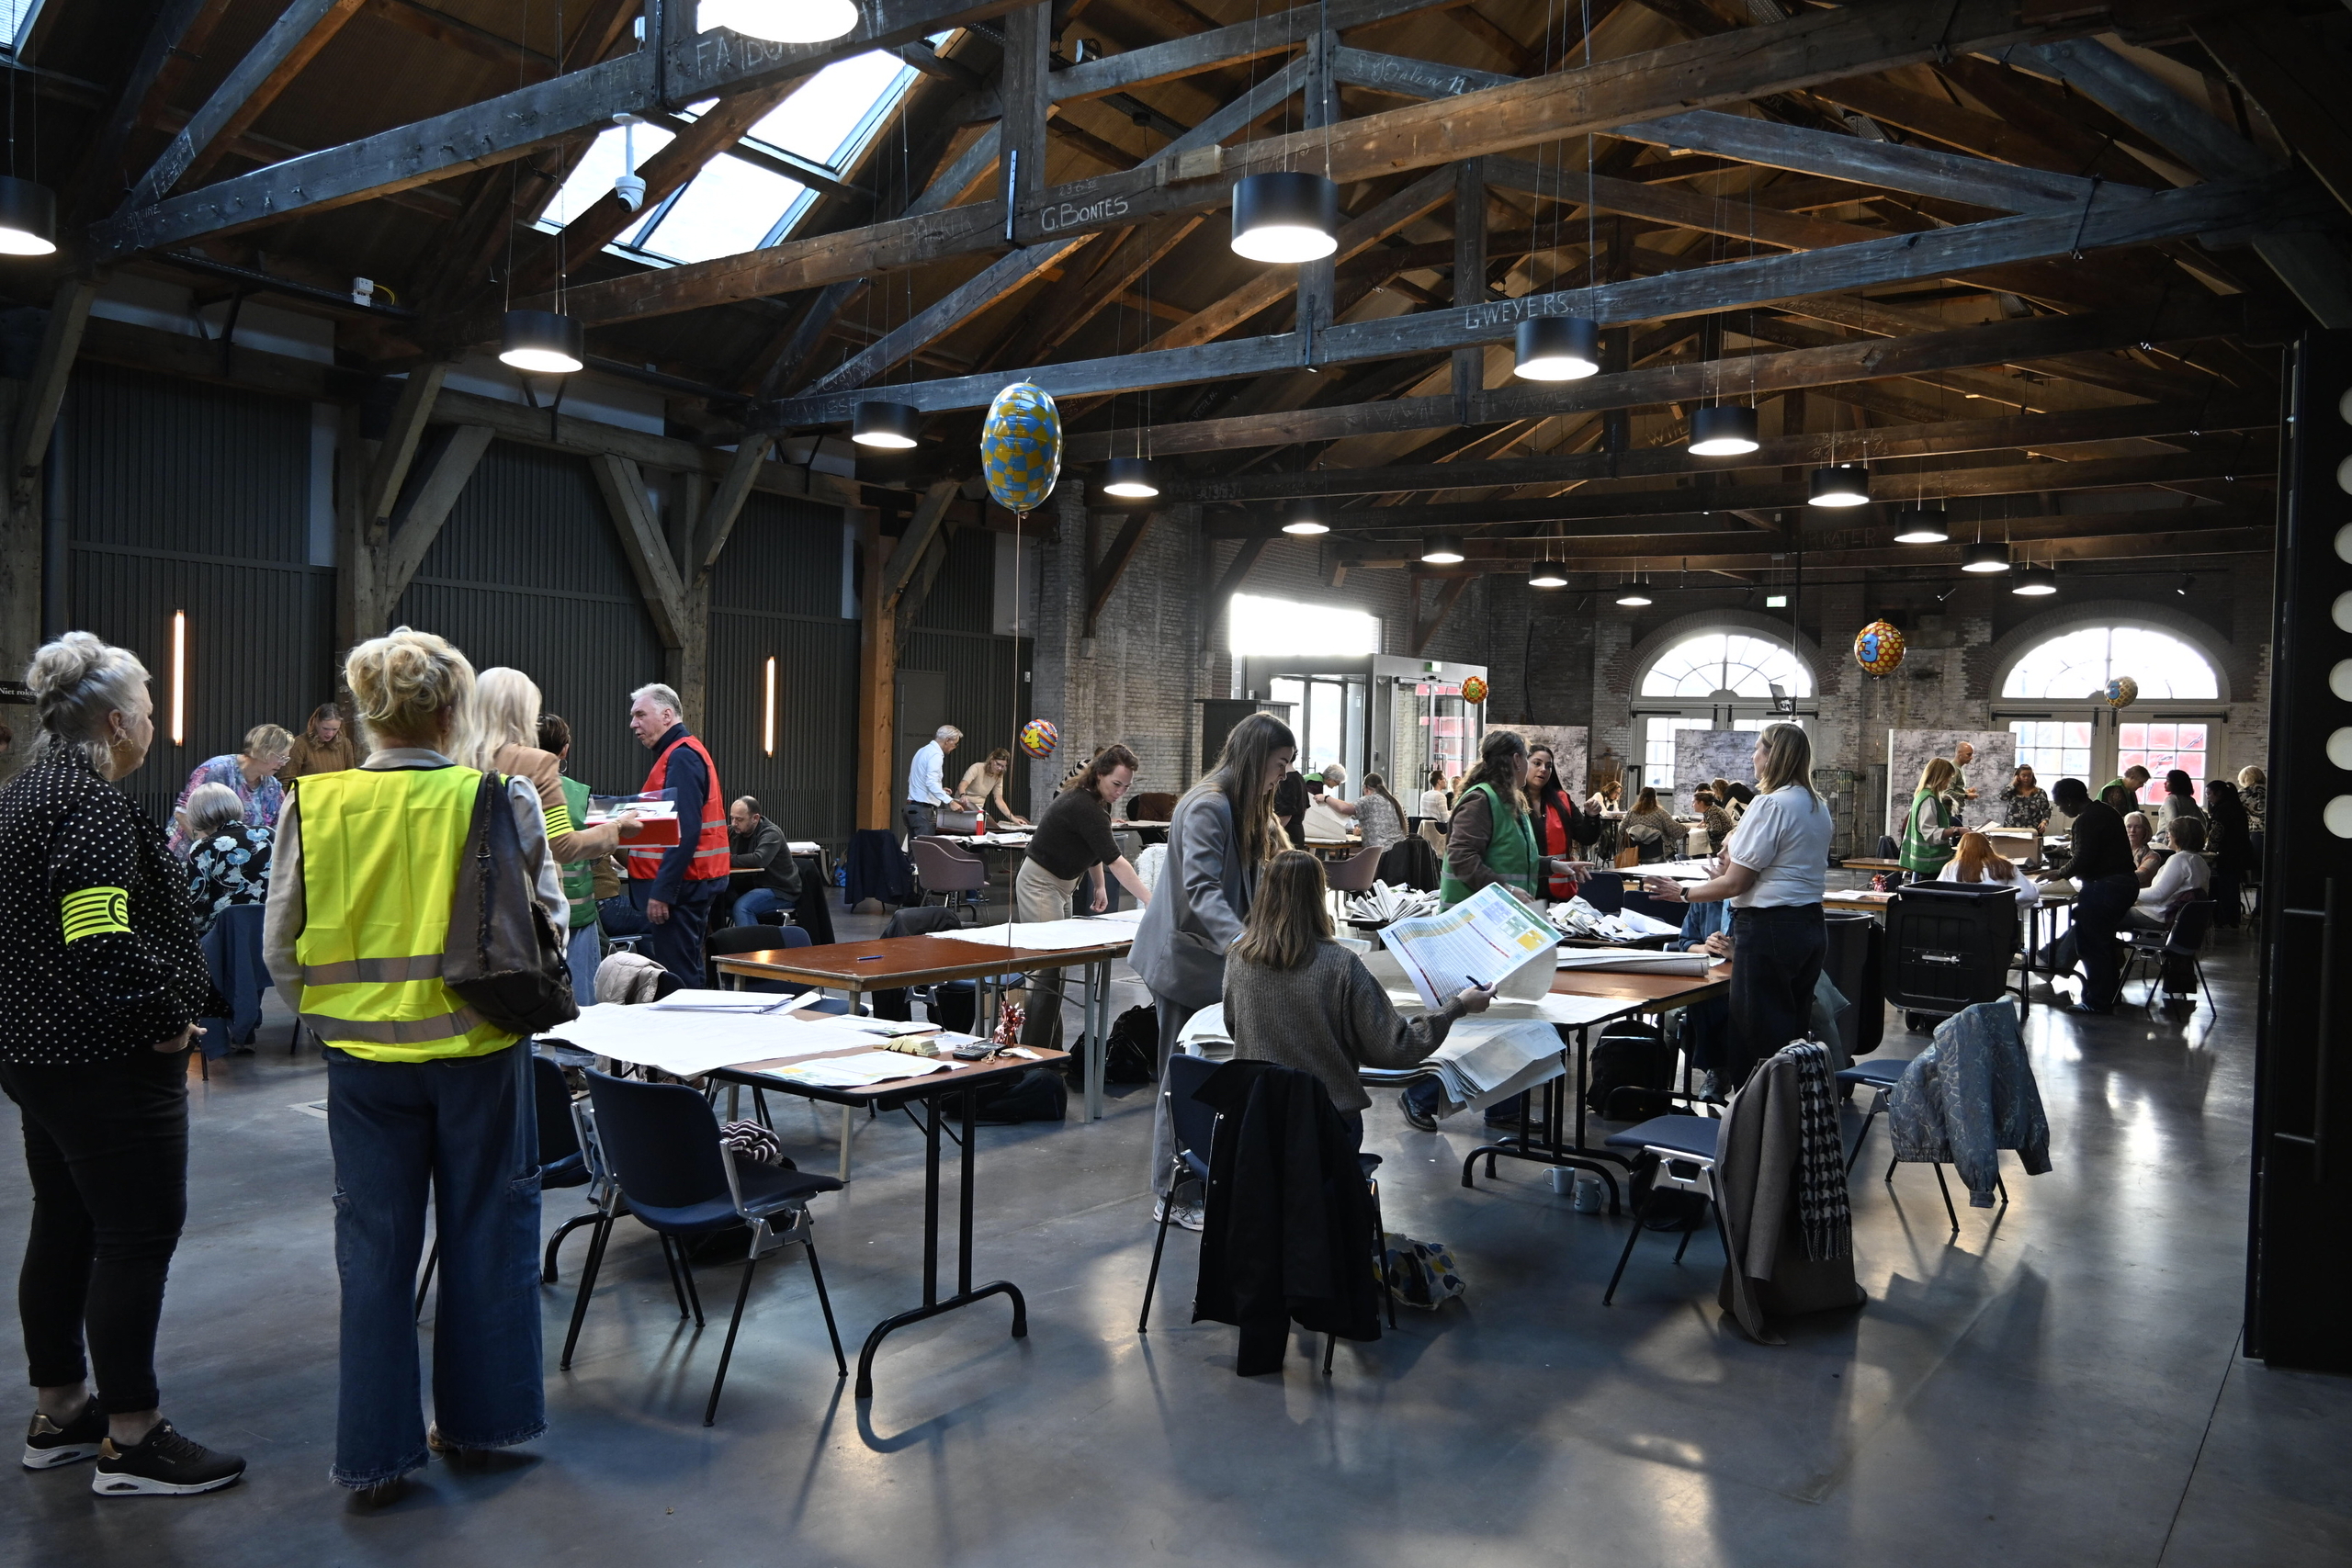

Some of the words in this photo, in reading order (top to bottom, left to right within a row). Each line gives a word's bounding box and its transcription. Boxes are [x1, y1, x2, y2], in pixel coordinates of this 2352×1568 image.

[1860, 633, 1879, 662] 3
[1468, 683, 1479, 698] 6
[1024, 728, 1040, 749] 4
